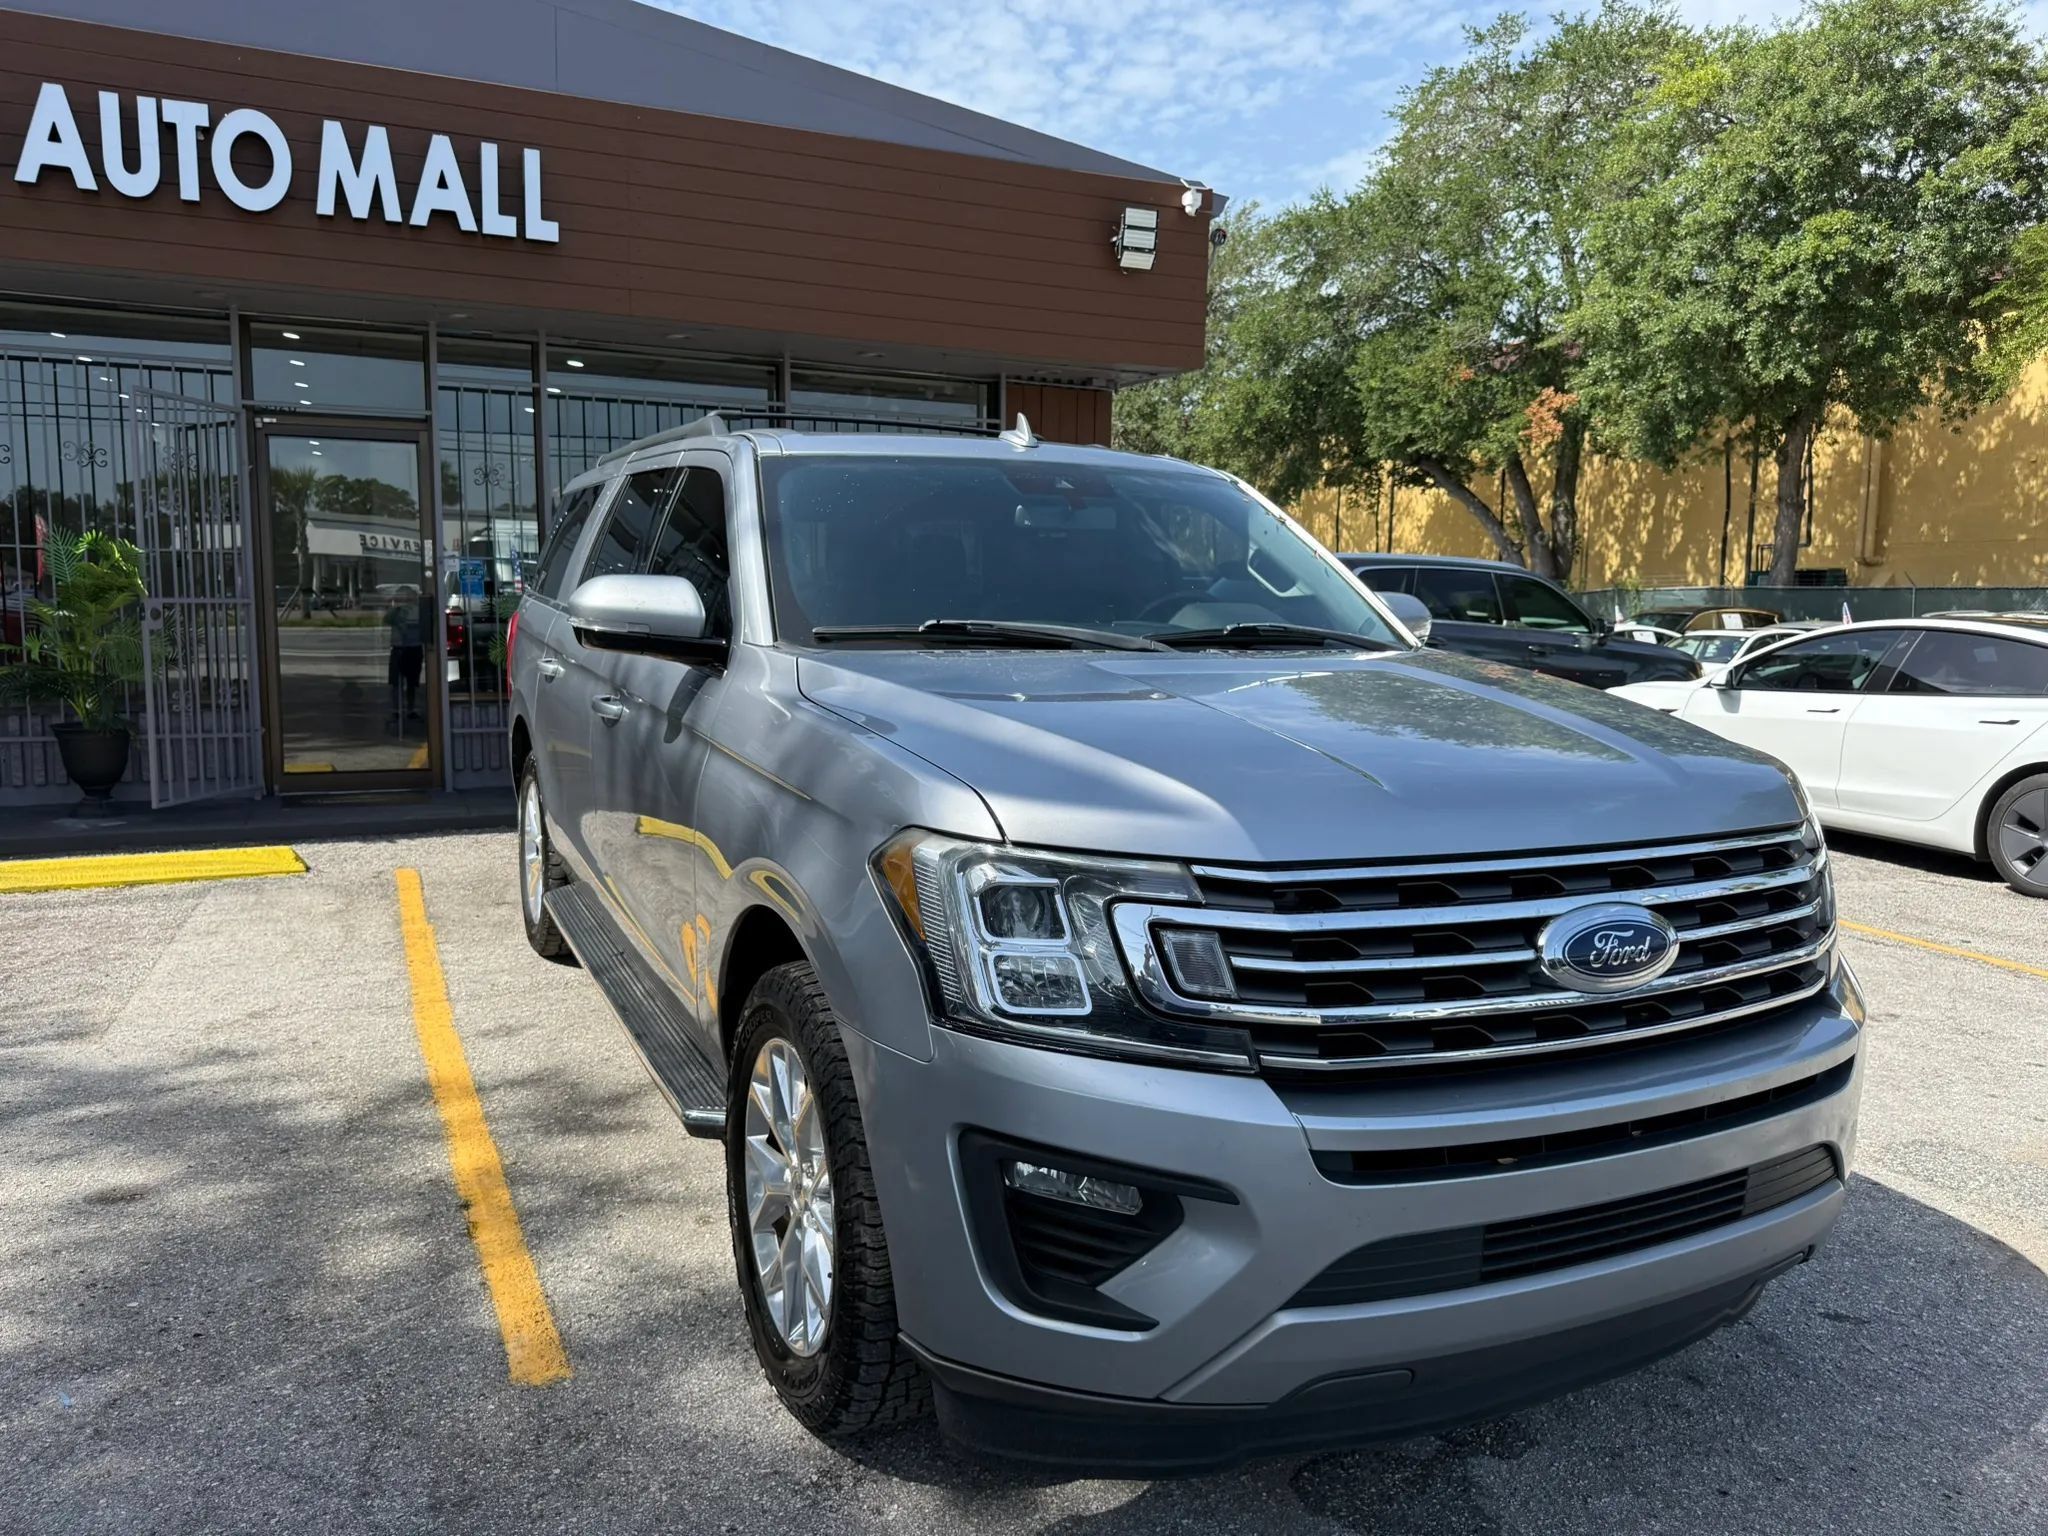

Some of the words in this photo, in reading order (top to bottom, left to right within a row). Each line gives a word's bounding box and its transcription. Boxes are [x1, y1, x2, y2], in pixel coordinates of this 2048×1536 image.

[14, 83, 292, 211] AUTO
[316, 119, 559, 242] MALL
[1591, 930, 1651, 967] Ford
[741, 1009, 773, 1047] COOPER
